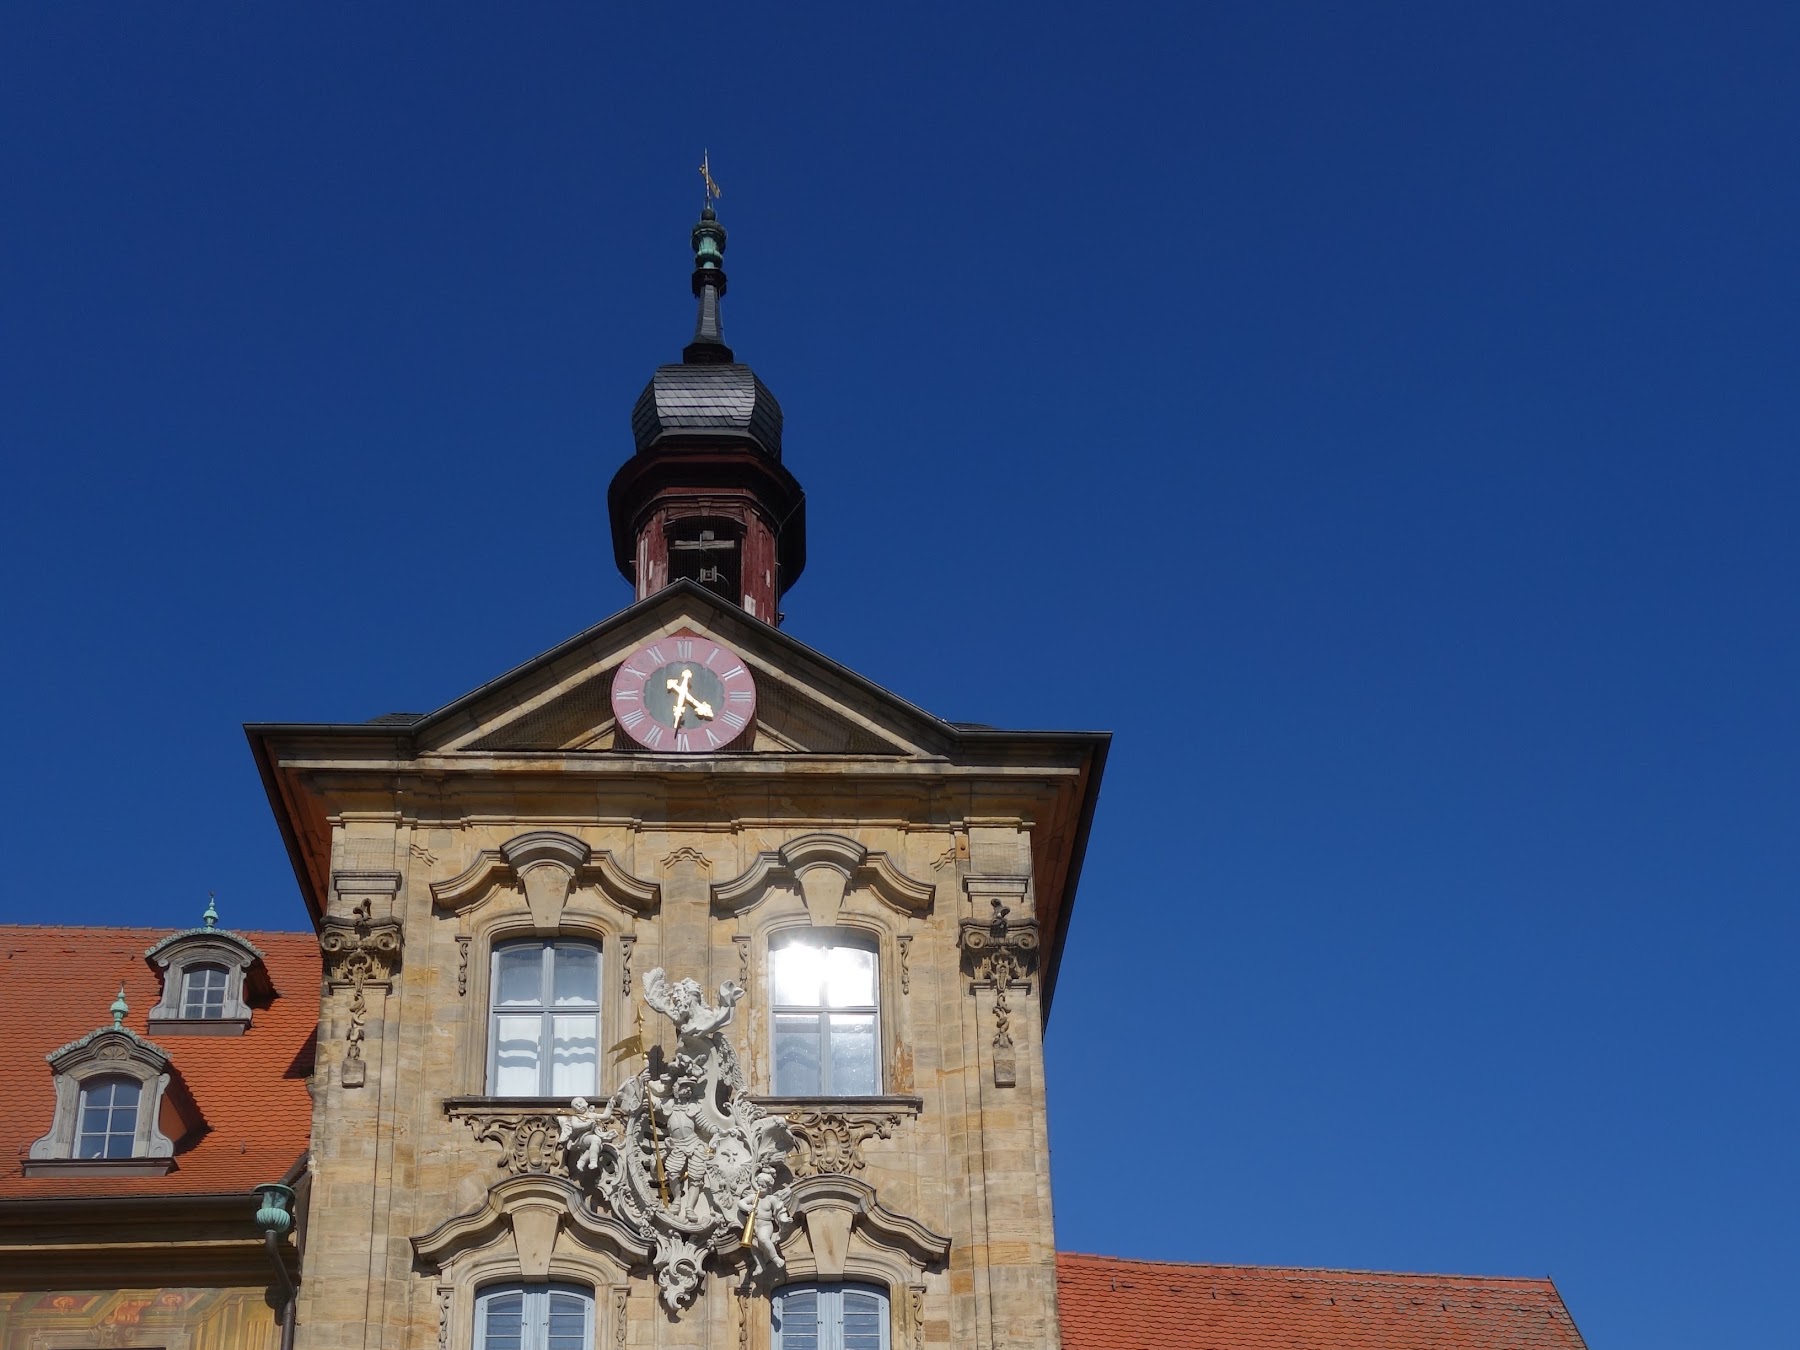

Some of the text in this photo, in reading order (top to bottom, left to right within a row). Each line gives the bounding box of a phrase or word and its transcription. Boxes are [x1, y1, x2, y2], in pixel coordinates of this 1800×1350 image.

[646, 646, 665, 666] XI
[677, 640, 692, 659] XII
[705, 647, 720, 665] I
[625, 664, 647, 680] X
[722, 665, 745, 682] II
[616, 689, 639, 700] IX
[729, 691, 752, 702] III
[622, 709, 646, 730] VIII
[720, 710, 746, 730] IIII
[643, 725, 664, 747] VII
[705, 728, 722, 747] V
